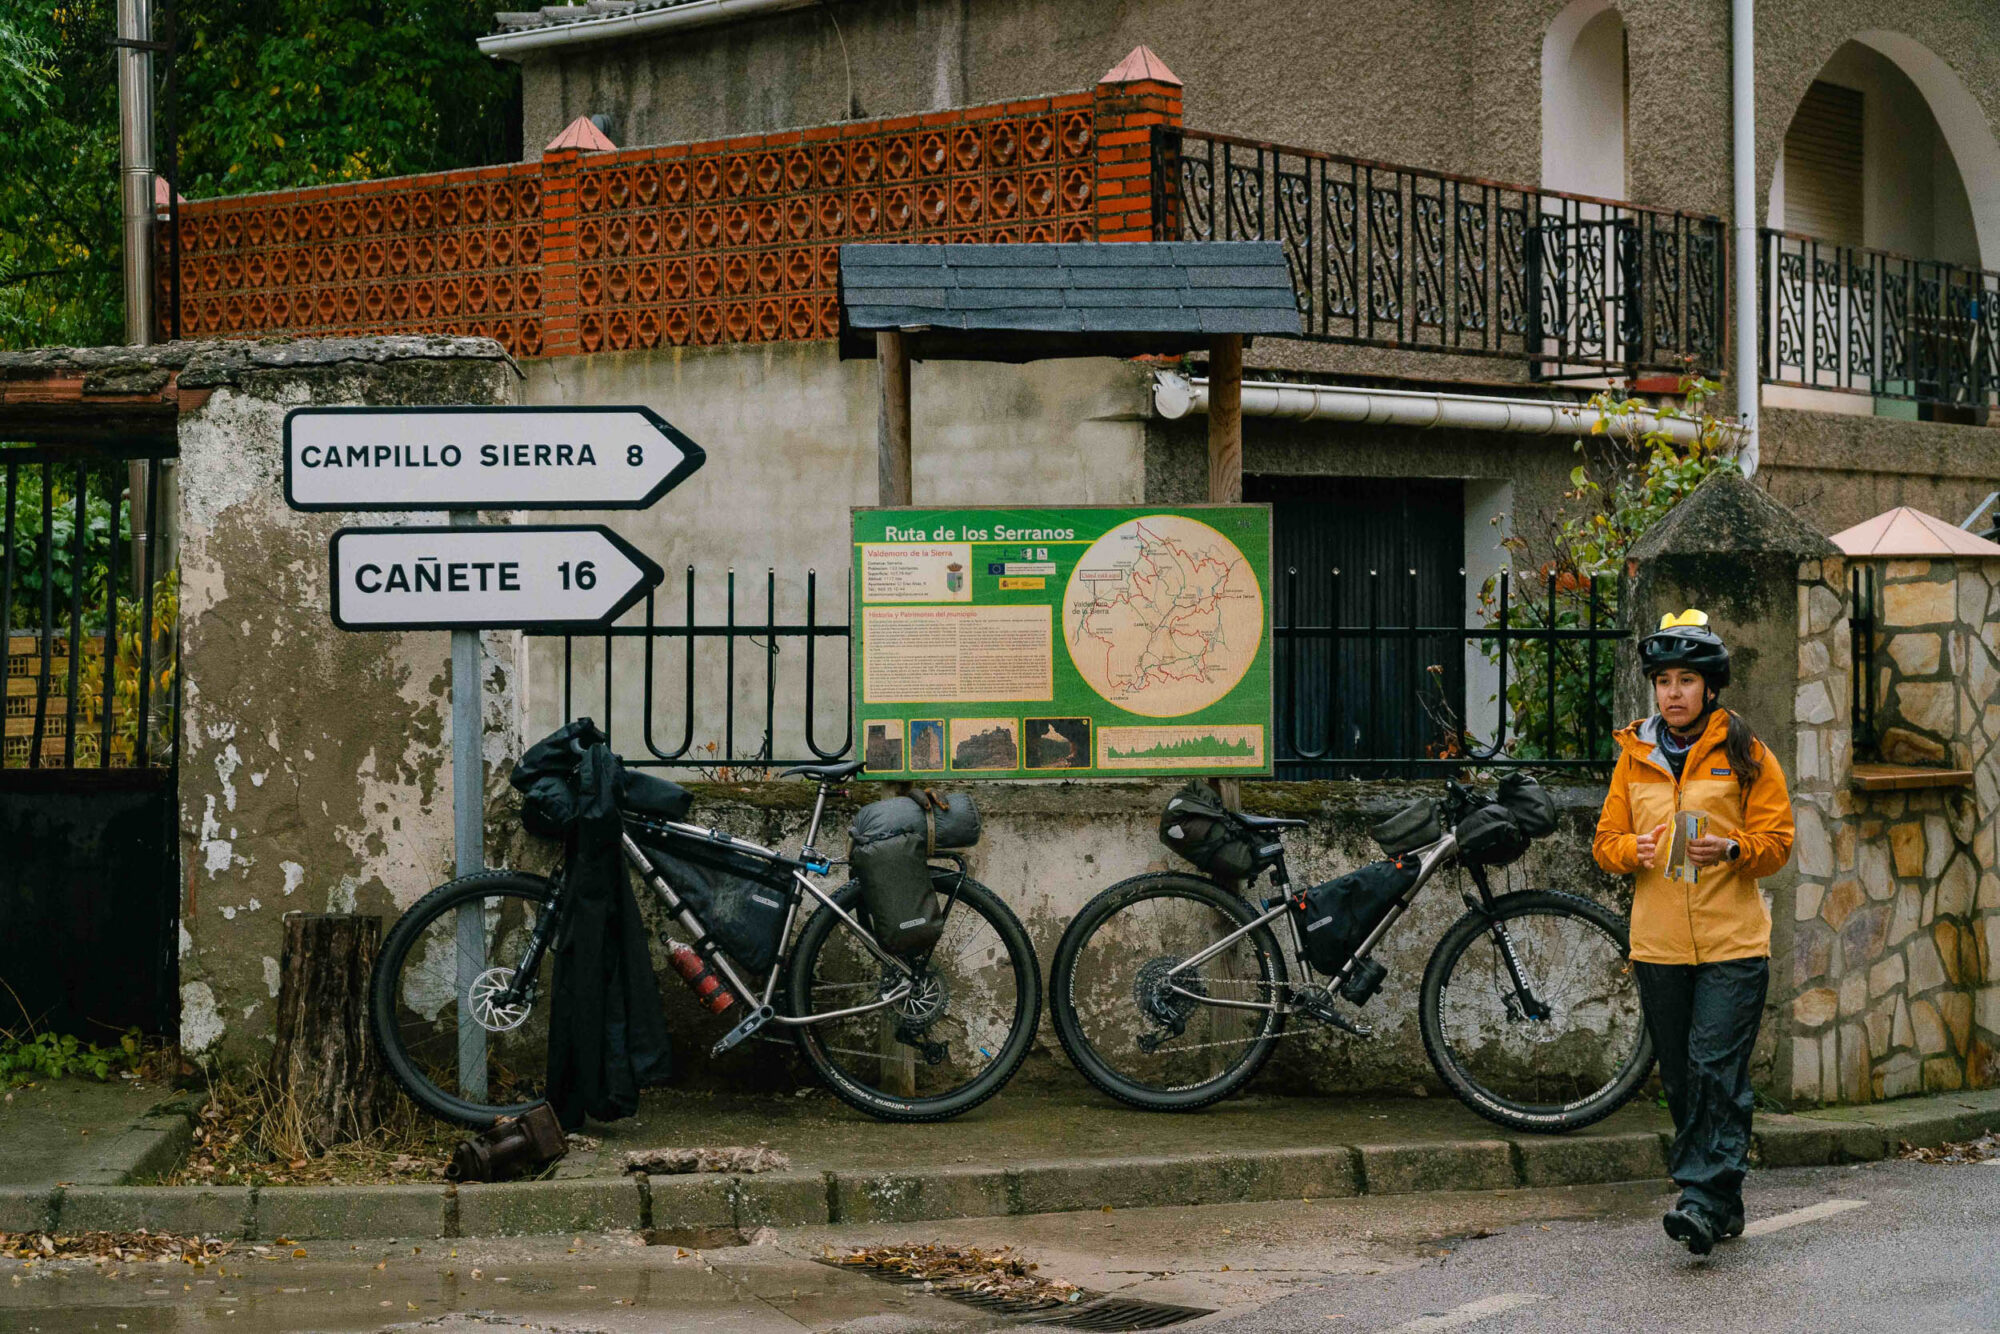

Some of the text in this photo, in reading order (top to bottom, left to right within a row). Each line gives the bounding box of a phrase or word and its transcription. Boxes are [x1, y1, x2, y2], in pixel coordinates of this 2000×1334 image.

[300, 444, 644, 468] CAMPILLO SIERRA 8
[885, 525, 1075, 541] Ruta de los Serranos
[354, 556, 597, 594] CAÑETE 16
[1503, 931, 1528, 990] manitou
[829, 1065, 873, 1101] MEZCAL
[1563, 1077, 1619, 1112] BONTRAGER
[1473, 1092, 1524, 1119] BARZO
